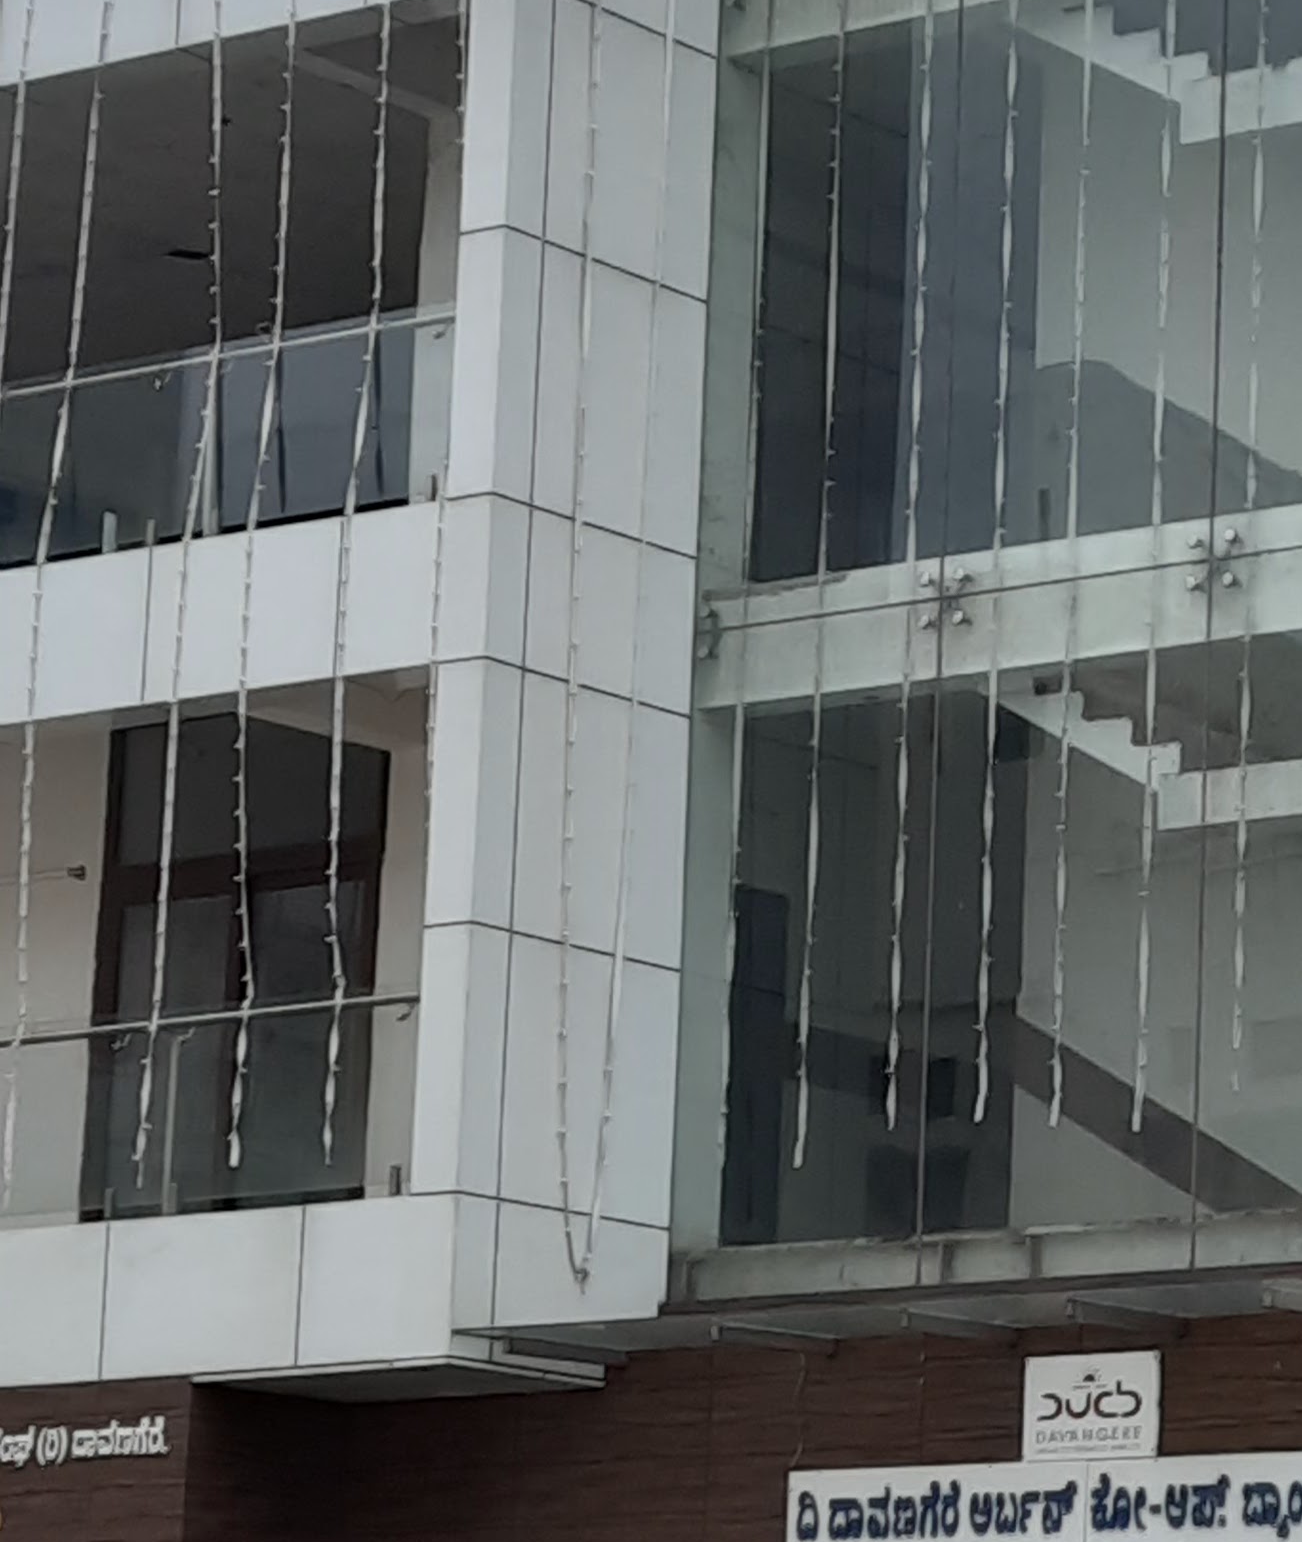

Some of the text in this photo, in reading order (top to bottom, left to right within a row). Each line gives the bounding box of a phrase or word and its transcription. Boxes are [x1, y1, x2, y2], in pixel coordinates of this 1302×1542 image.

[796, 1490, 819, 1541] ದಿ
[828, 1479, 961, 1540] ದಾವಣಗೆರೆ
[969, 1480, 1077, 1535] ಅರ್ಬನ್
